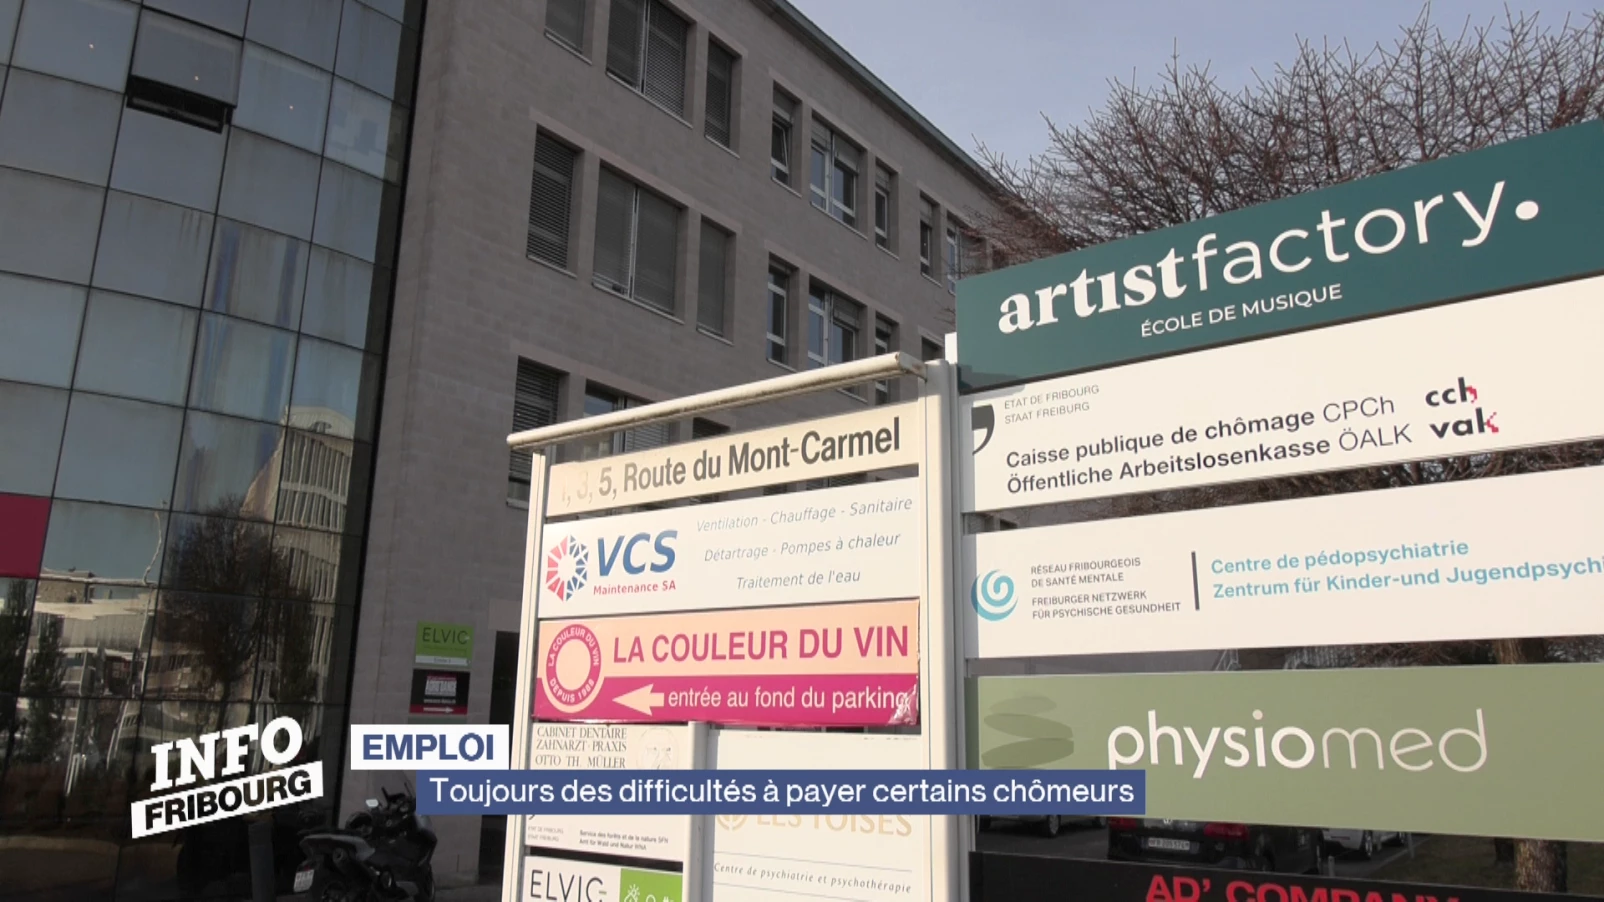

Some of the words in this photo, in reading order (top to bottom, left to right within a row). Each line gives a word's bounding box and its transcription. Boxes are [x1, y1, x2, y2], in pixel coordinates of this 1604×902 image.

[1141, 318, 1203, 338] ÉCOLE
[1208, 306, 1236, 324] DE
[1242, 283, 1344, 317] MUSIQUE
[1030, 394, 1044, 405] DE
[1045, 384, 1100, 402] FRIBOURG
[1425, 376, 1478, 407] cch
[1004, 411, 1033, 424] STAAT
[1036, 401, 1090, 419] FREIBURG
[1428, 407, 1499, 439] vak
[1006, 447, 1070, 468] Caisse
[1076, 433, 1164, 461] publique
[1171, 426, 1198, 445] de
[1205, 410, 1315, 440] chômage
[1322, 396, 1395, 423] CPCh
[598, 466, 618, 501] 5,
[623, 460, 687, 493] Route
[692, 449, 722, 482] du
[728, 416, 900, 476] Mont-Carmel
[1007, 467, 1113, 493] Öffentliche
[1119, 440, 1331, 480] Arbeitslosenkasse
[1338, 423, 1413, 451] ÖALK
[696, 514, 758, 532] Ventilation
[770, 507, 836, 525] Chauffage
[849, 497, 913, 516] Sanitaire
[597, 529, 678, 577] VCS
[704, 545, 769, 562] Détartrage
[780, 540, 832, 556] Pompes
[835, 536, 844, 550] à
[847, 533, 901, 549] chaleur
[1211, 556, 1272, 574] Centre
[1276, 552, 1300, 569] de
[1305, 540, 1470, 571] pédopsychiatrie
[736, 573, 804, 590] Traitement
[807, 572, 824, 585] de
[828, 570, 861, 584] l'eau
[1030, 564, 1067, 575] RÉSEAU
[1069, 557, 1141, 572] FRIBOURGEOIS
[1031, 578, 1044, 588] DE
[1046, 575, 1077, 587] SANTÉ
[1078, 572, 1124, 585] MENTALE
[593, 583, 659, 595] Maintenance
[662, 580, 676, 592] SA
[1032, 594, 1090, 606] FREIBURGER
[1091, 590, 1147, 603] NETZWERK
[1213, 580, 1290, 599] Zentrum
[1294, 577, 1321, 594] für
[1327, 569, 1441, 591] Kinder-und
[1032, 608, 1051, 619] FÜR
[1052, 607, 1114, 618] PSYCHISCHE
[1115, 602, 1181, 615] GESUNDHEIT
[548, 653, 556, 667] LA
[552, 627, 586, 652] COULEUR
[592, 647, 600, 667] VIN
[613, 635, 645, 663] LA
[652, 630, 788, 663] COULEUR
[799, 628, 843, 659] DU
[853, 625, 908, 657] VIN
[549, 677, 576, 704] DEPUIS
[668, 686, 722, 708] entrée
[726, 692, 748, 708] au
[754, 686, 795, 708] fond
[801, 686, 825, 708] du
[535, 739, 587, 751] ZAHNARZT
[592, 740, 627, 752] PRAXIS
[536, 726, 579, 738] CABINET
[579, 727, 627, 739] DENTAIRE
[1106, 707, 1488, 779] physiomed
[535, 754, 562, 766] OTTO
[587, 754, 626, 769] MÜLLER
[530, 869, 605, 902] ELVIC
[714, 862, 744, 875] Centre
[747, 865, 758, 876] de
[760, 868, 814, 883] psychiatrie
[817, 874, 828, 884] et
[830, 876, 912, 894] psychothérapie
